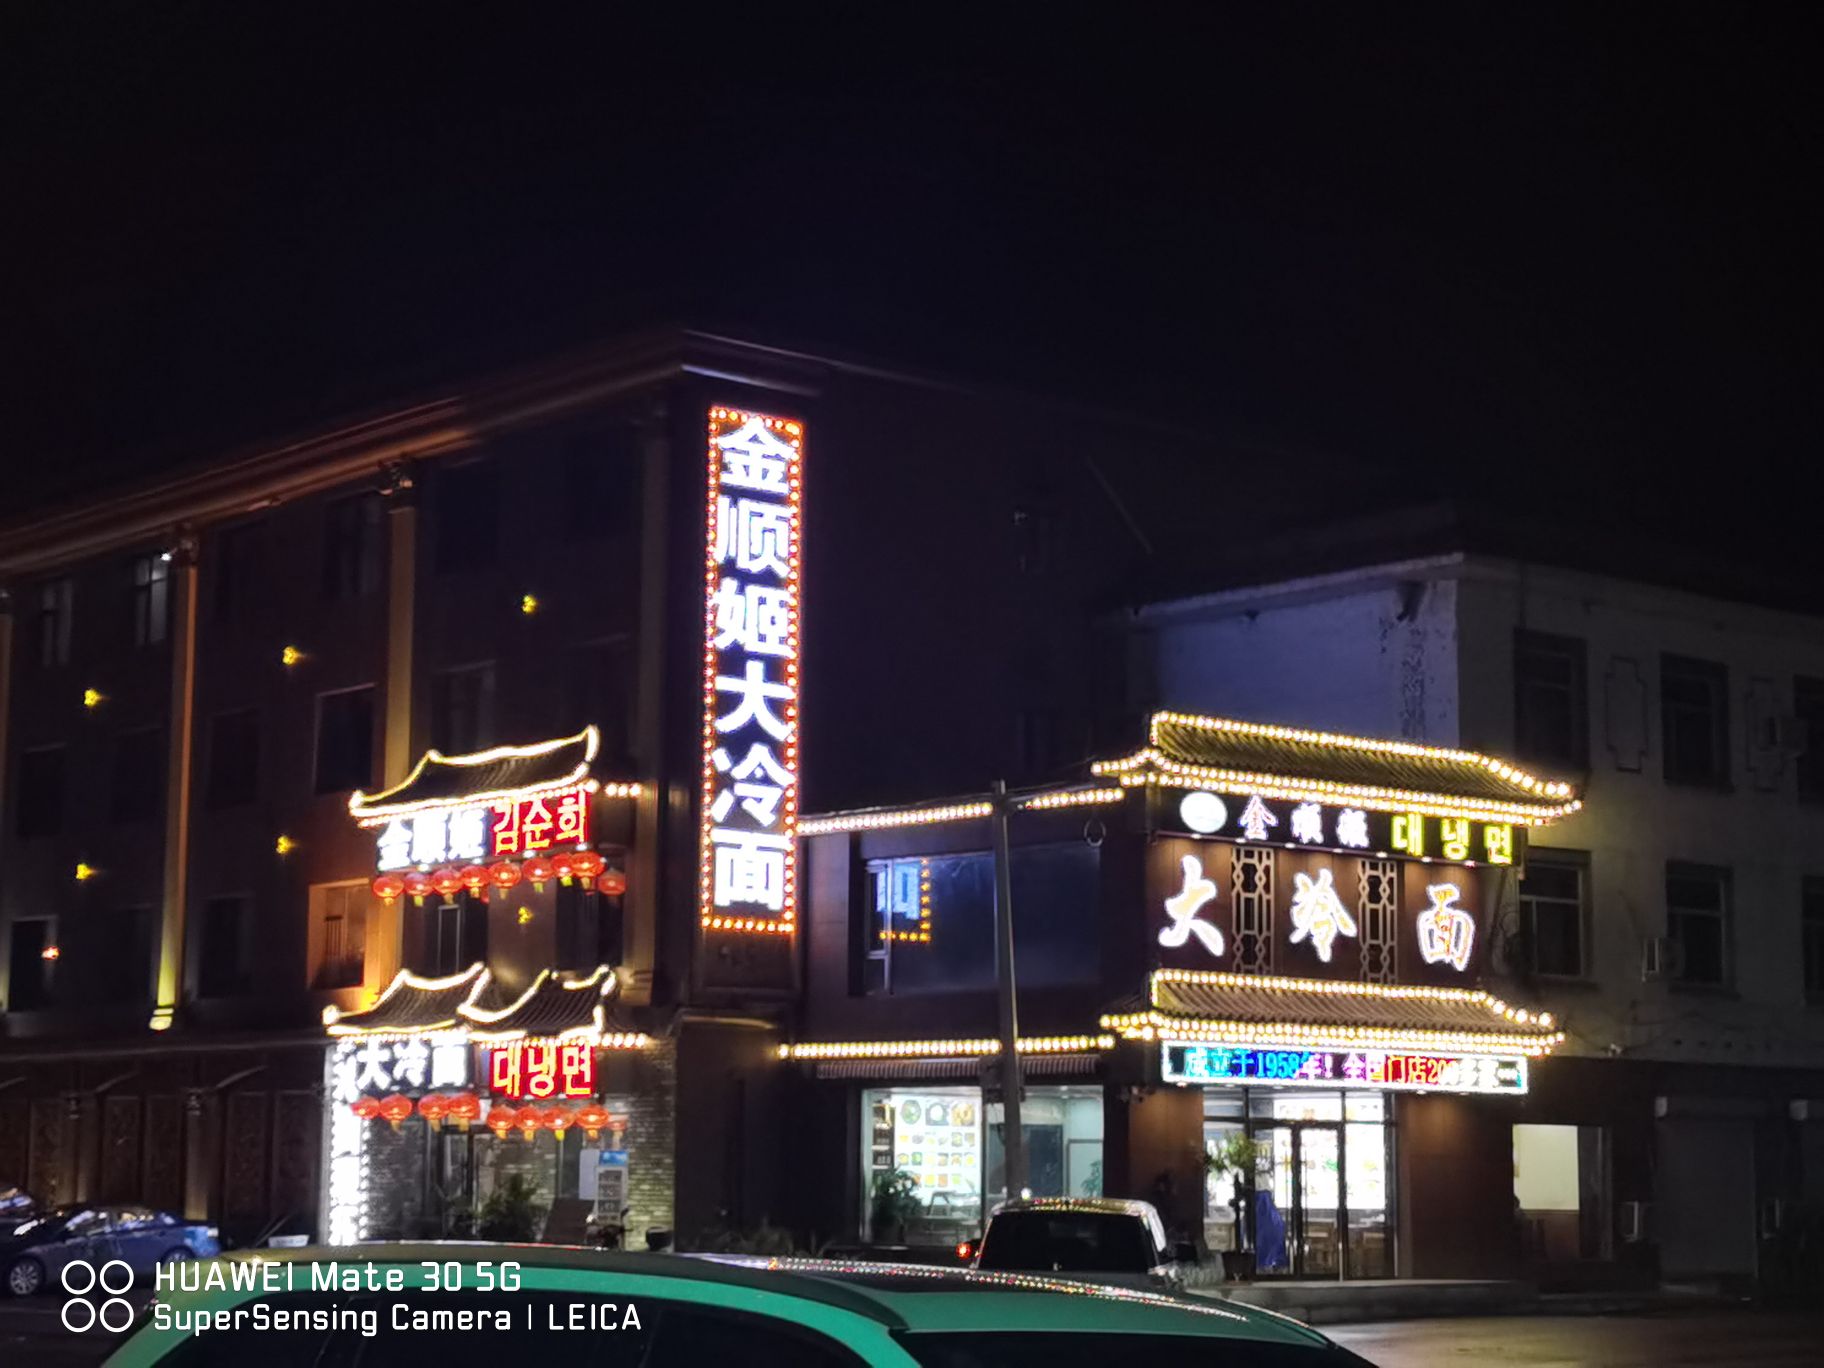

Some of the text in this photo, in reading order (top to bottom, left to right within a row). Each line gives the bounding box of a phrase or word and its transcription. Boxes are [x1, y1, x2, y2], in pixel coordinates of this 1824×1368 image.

[711, 415, 797, 911] 金顺姬大冷面
[493, 790, 585, 857] 김순희
[1391, 813, 1512, 865] 대냉면
[494, 1042, 591, 1096] 대냉면
